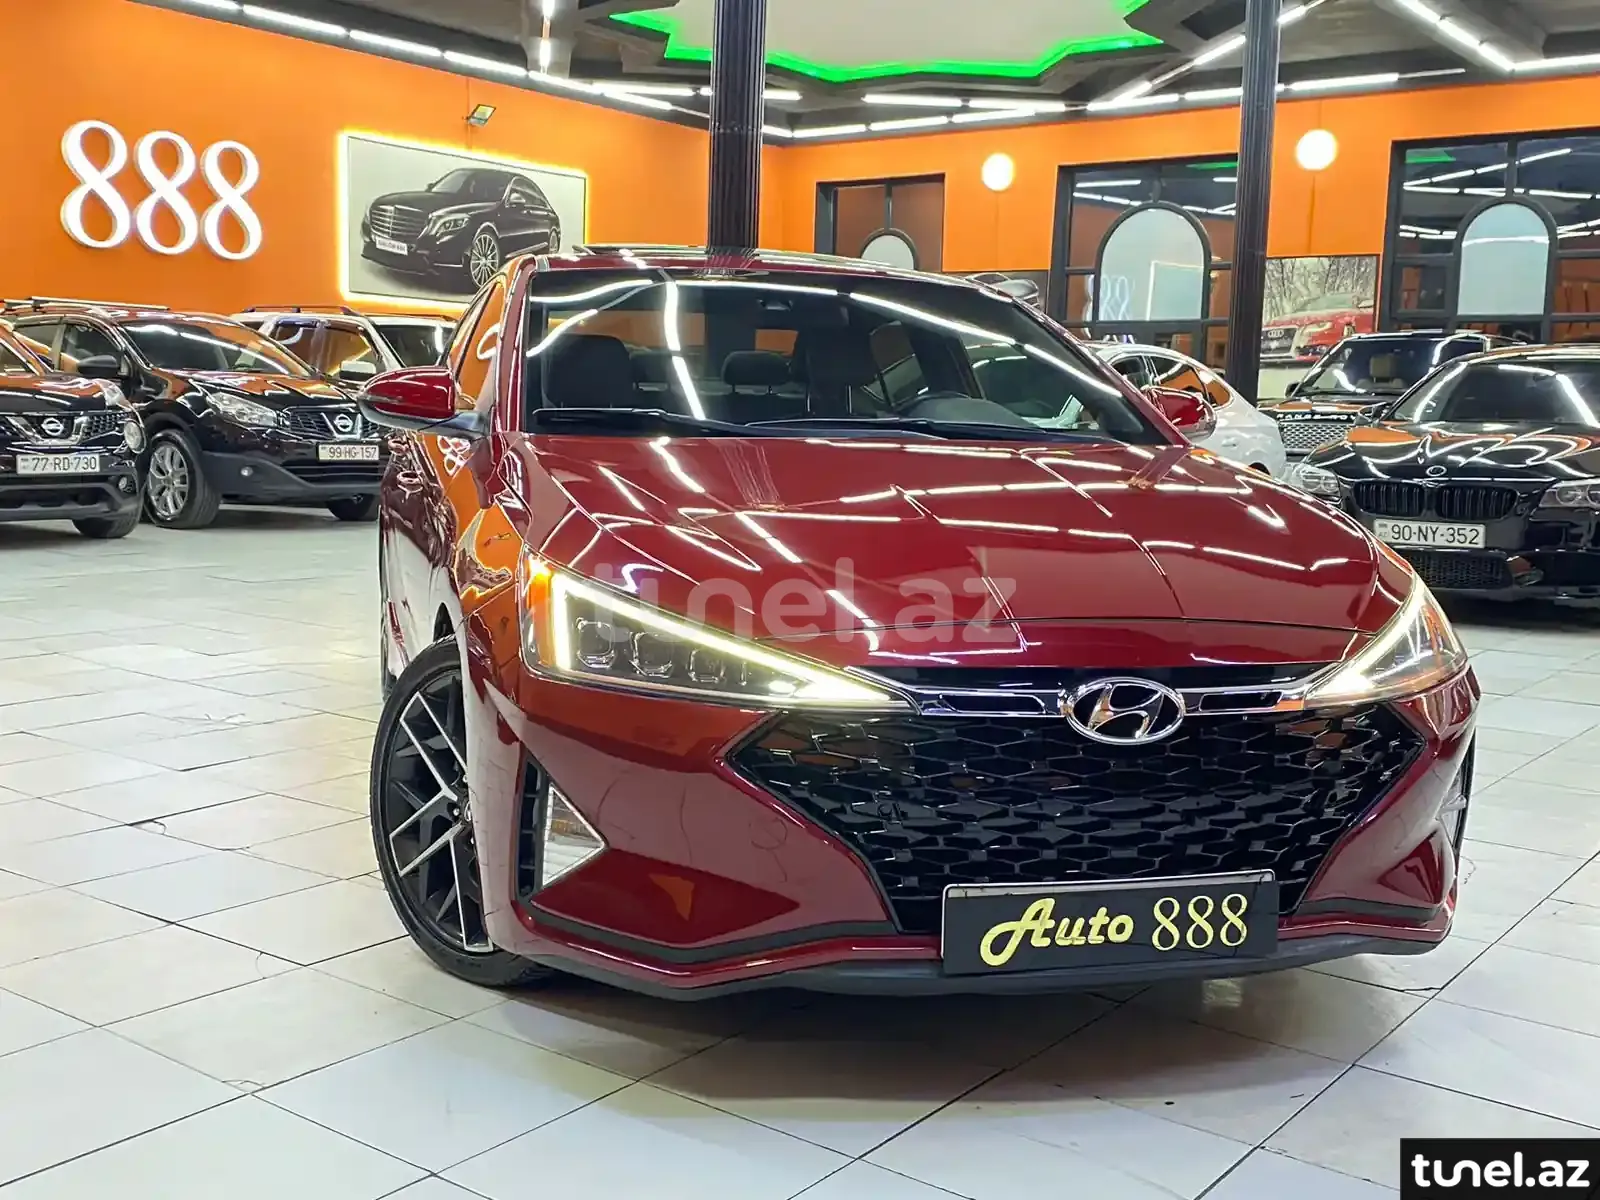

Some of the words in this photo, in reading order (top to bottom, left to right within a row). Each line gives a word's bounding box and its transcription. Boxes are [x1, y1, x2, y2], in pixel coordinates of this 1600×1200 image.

[60, 119, 263, 260] 888
[31, 456, 97, 472] 77-RD-730
[1391, 523, 1480, 546] 90-NY-352
[979, 897, 1135, 966] Auto
[1151, 893, 1249, 951] 888
